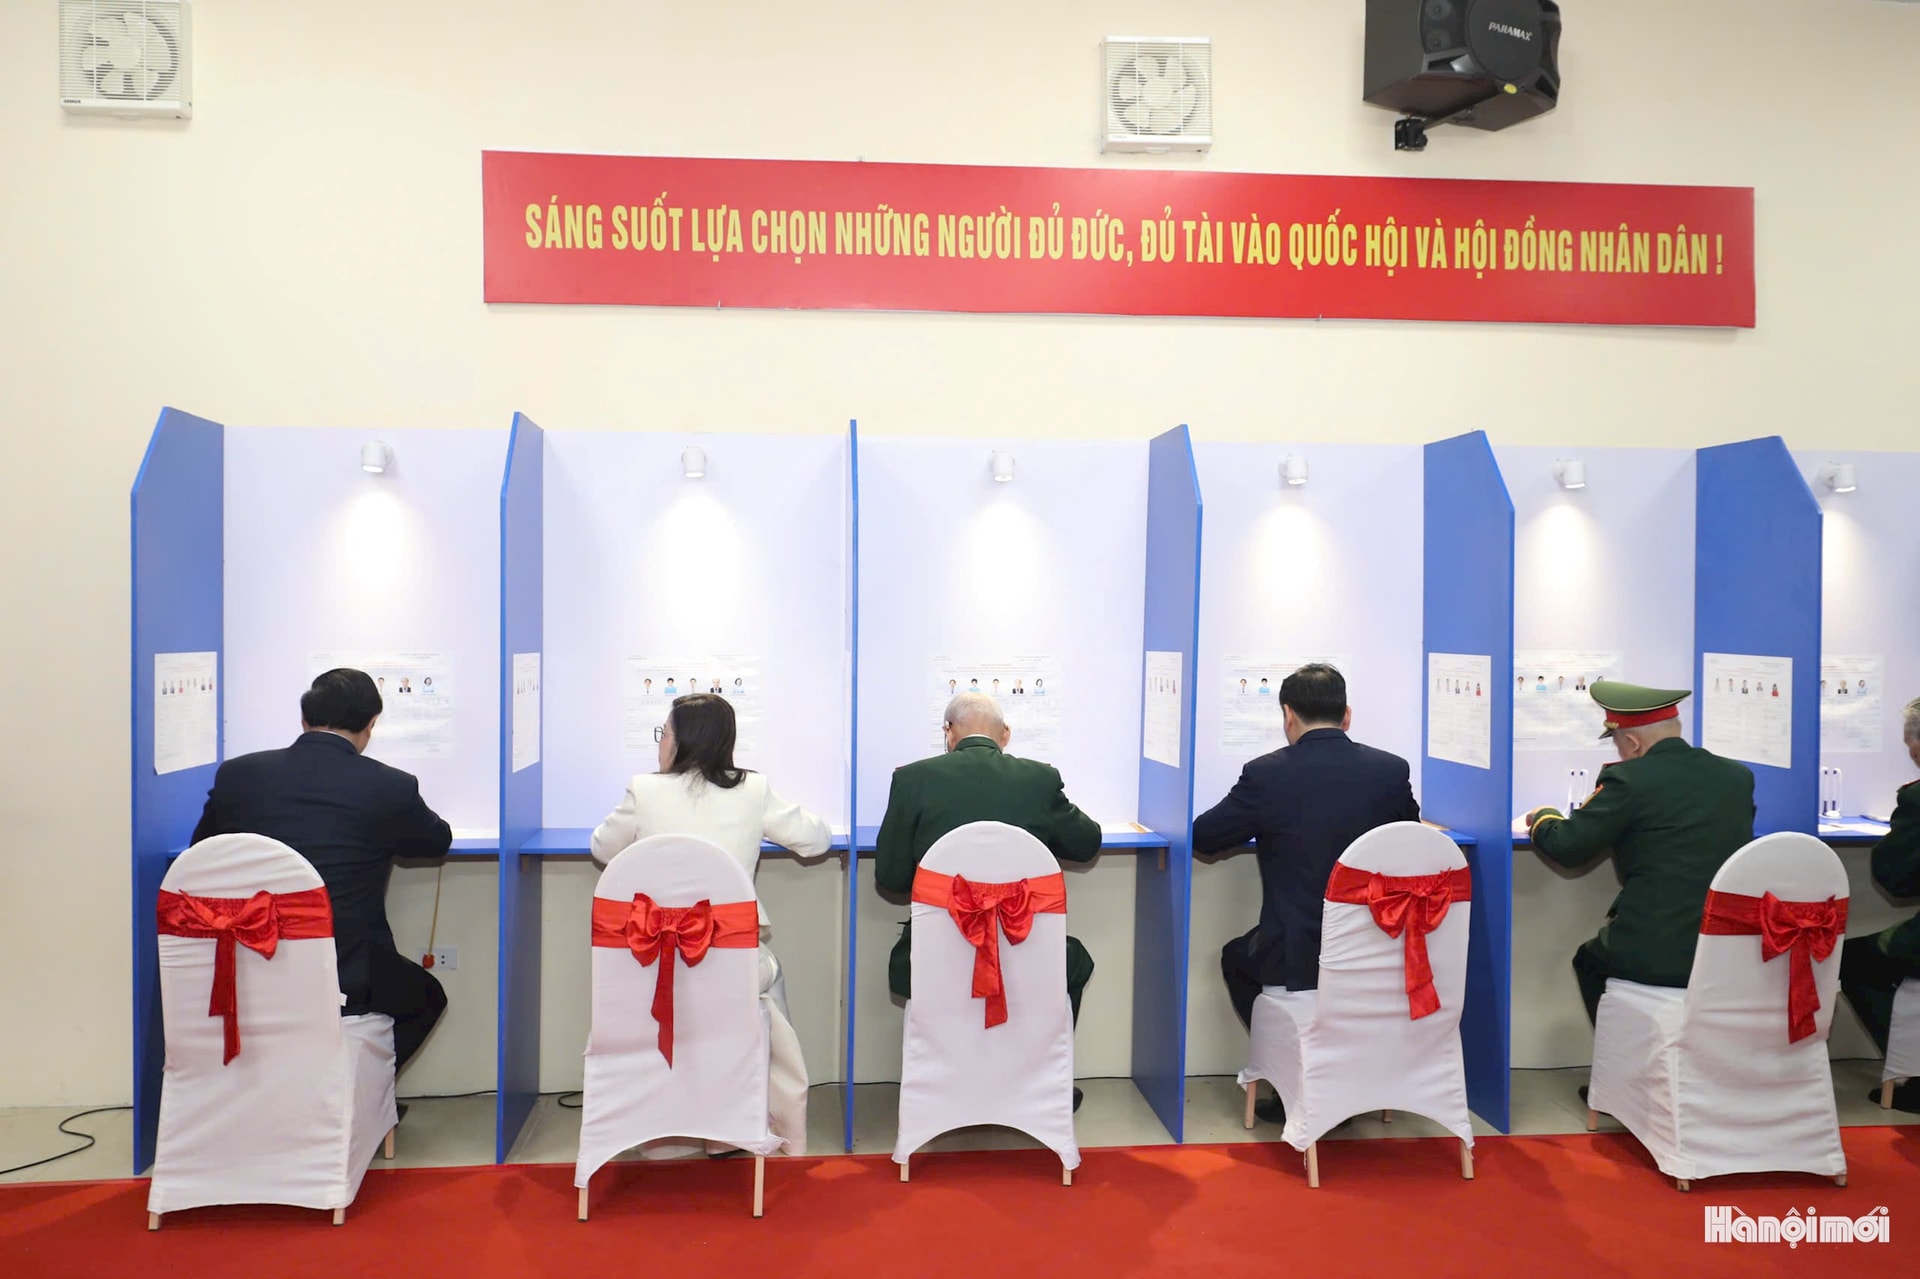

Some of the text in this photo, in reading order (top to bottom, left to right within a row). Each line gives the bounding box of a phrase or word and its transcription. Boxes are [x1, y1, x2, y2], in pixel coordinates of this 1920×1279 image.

[1488, 21, 1531, 41] PARAMAX
[524, 194, 604, 250] SÁNG
[611, 191, 684, 252] SUỐT
[691, 203, 745, 263] LỰA
[751, 208, 827, 265] CHỌN
[834, 203, 930, 257] NHỮNG
[937, 204, 1022, 260] NGƯỜI
[1028, 201, 1065, 261] ĐỦ
[1070, 208, 1134, 268] ĐỨC,
[1139, 204, 1176, 263] ĐỦ
[1181, 211, 1224, 264] TÀI
[1230, 212, 1281, 266] VÀO
[1288, 208, 1358, 271] QUỐC
[1365, 216, 1408, 277] HỘI
[1415, 218, 1448, 269] VÀ
[1454, 218, 1497, 279] HỘI
[1503, 215, 1573, 272] ĐỒNG
[1580, 222, 1650, 273] NHÂN
[1657, 224, 1708, 275] DÂN
